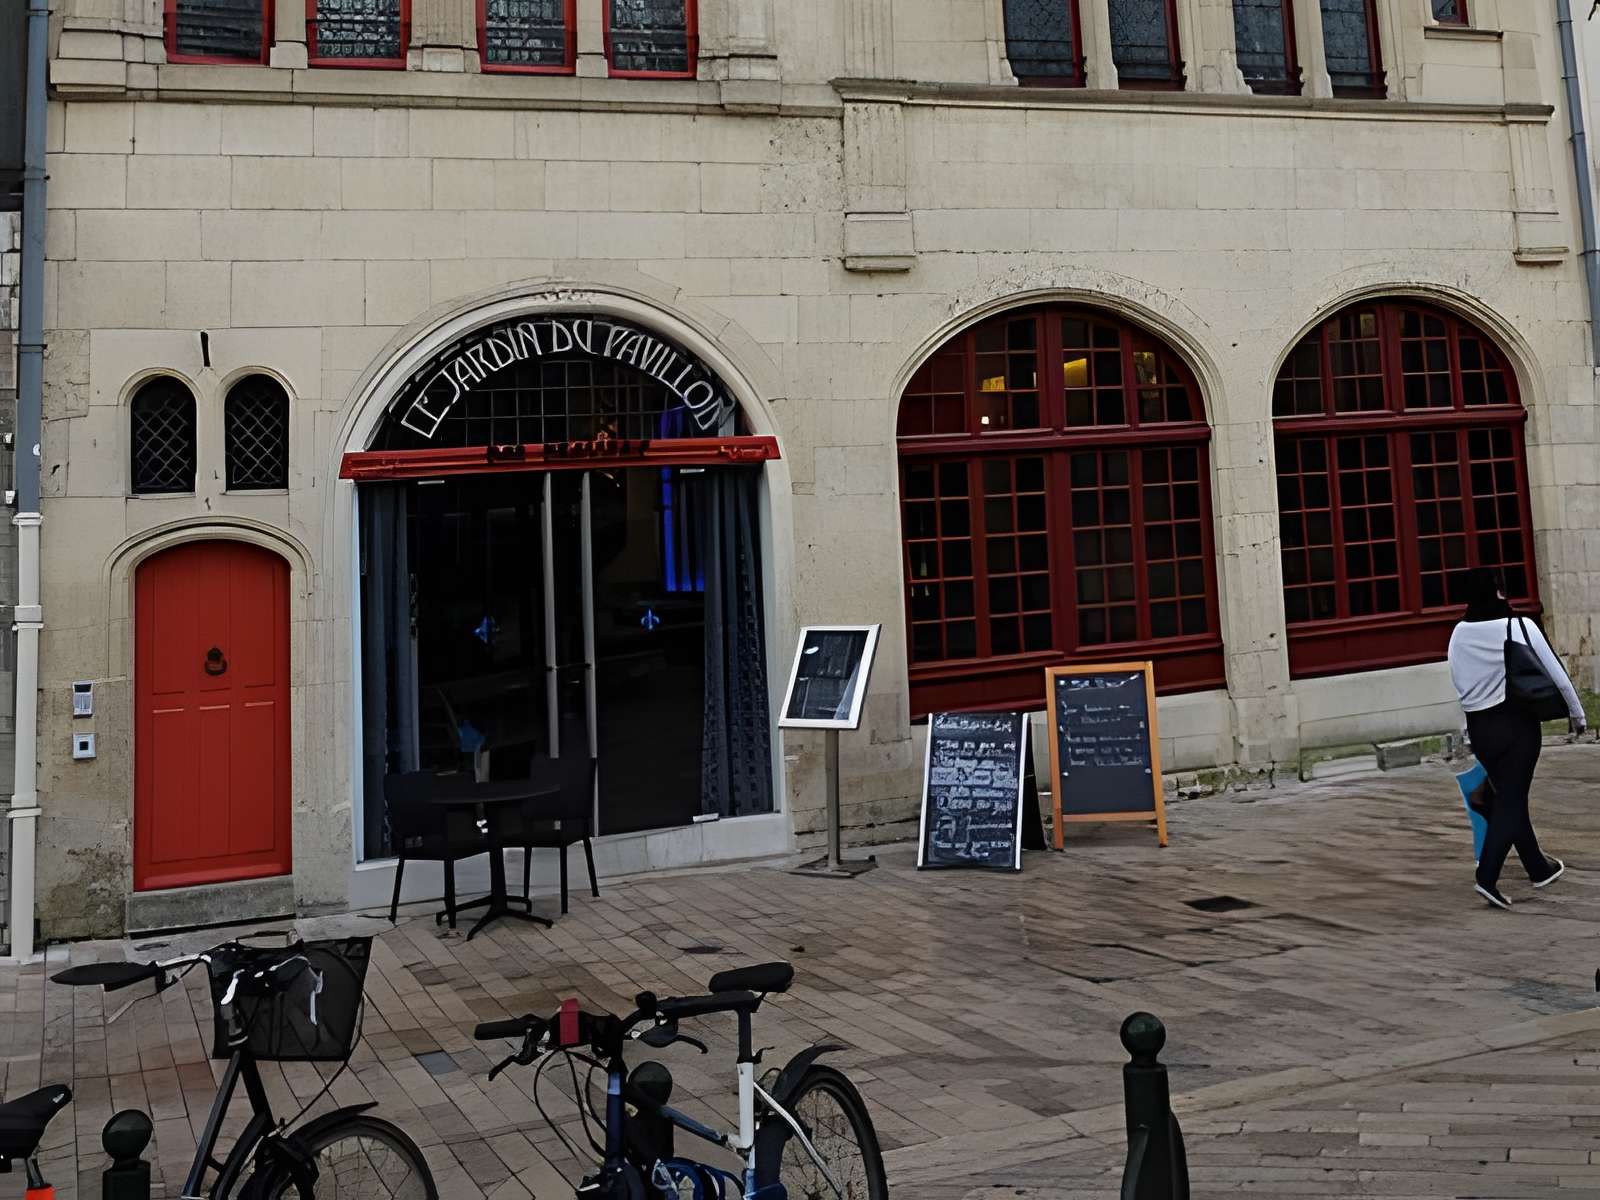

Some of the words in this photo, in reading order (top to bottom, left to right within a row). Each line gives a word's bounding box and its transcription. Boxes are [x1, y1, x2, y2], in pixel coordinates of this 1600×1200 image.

[442, 323, 542, 404] JARDIN
[552, 319, 597, 354] DU
[603, 326, 727, 430] PAVILLON
